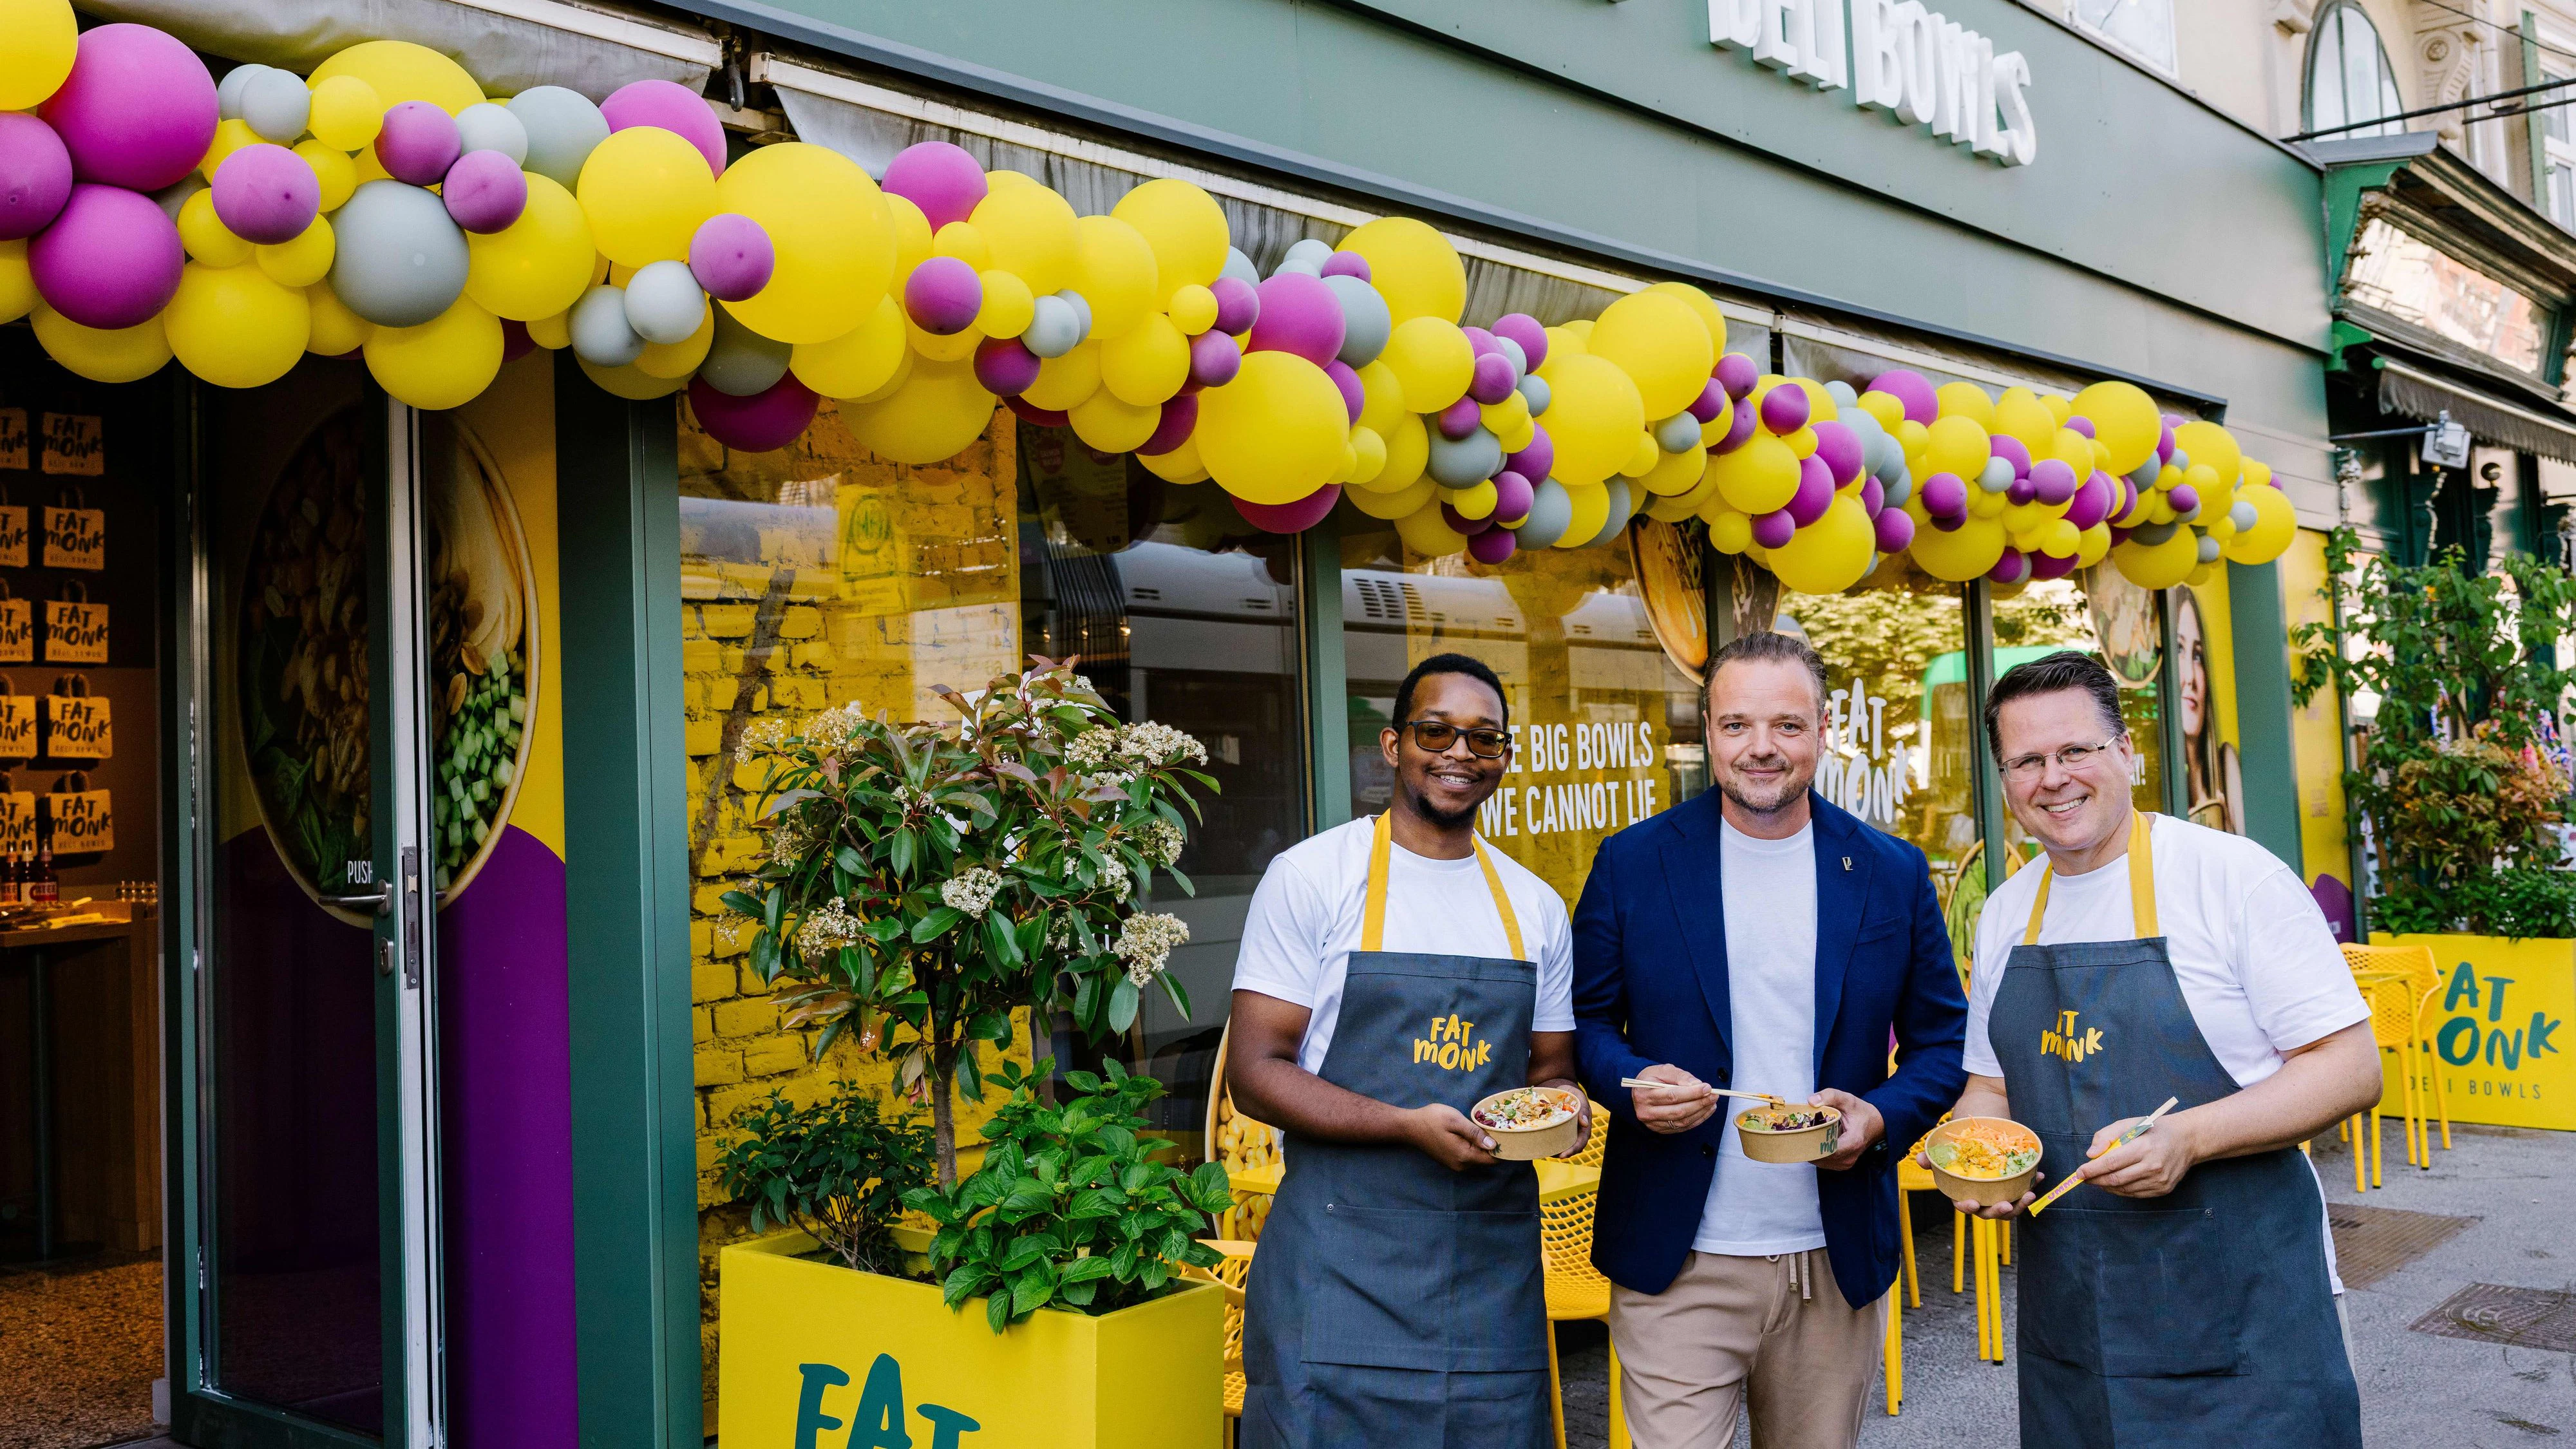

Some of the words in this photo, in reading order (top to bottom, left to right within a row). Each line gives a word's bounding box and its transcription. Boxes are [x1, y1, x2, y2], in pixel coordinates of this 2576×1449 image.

[1853, 0, 2037, 167] BOWLS
[55, 512, 89, 535] FAT
[58, 605, 91, 628] FAT
[0, 717, 35, 741] NK
[61, 701, 95, 724] FAT
[1831, 677, 1887, 761] FAT
[1530, 723, 1569, 773] BIG
[1577, 721, 1654, 770] BOWLS
[63, 796, 96, 817] FAT
[1481, 787, 1518, 838] WE
[1526, 781, 1620, 835] CANNOT
[0, 815, 36, 839] NK
[2442, 961, 2515, 1023] AT
[1430, 1014, 1474, 1047] FAT
[2436, 1011, 2562, 1072] ONK
[2469, 1079, 2543, 1100] BOWLS
[794, 1352, 982, 1449] FAT
